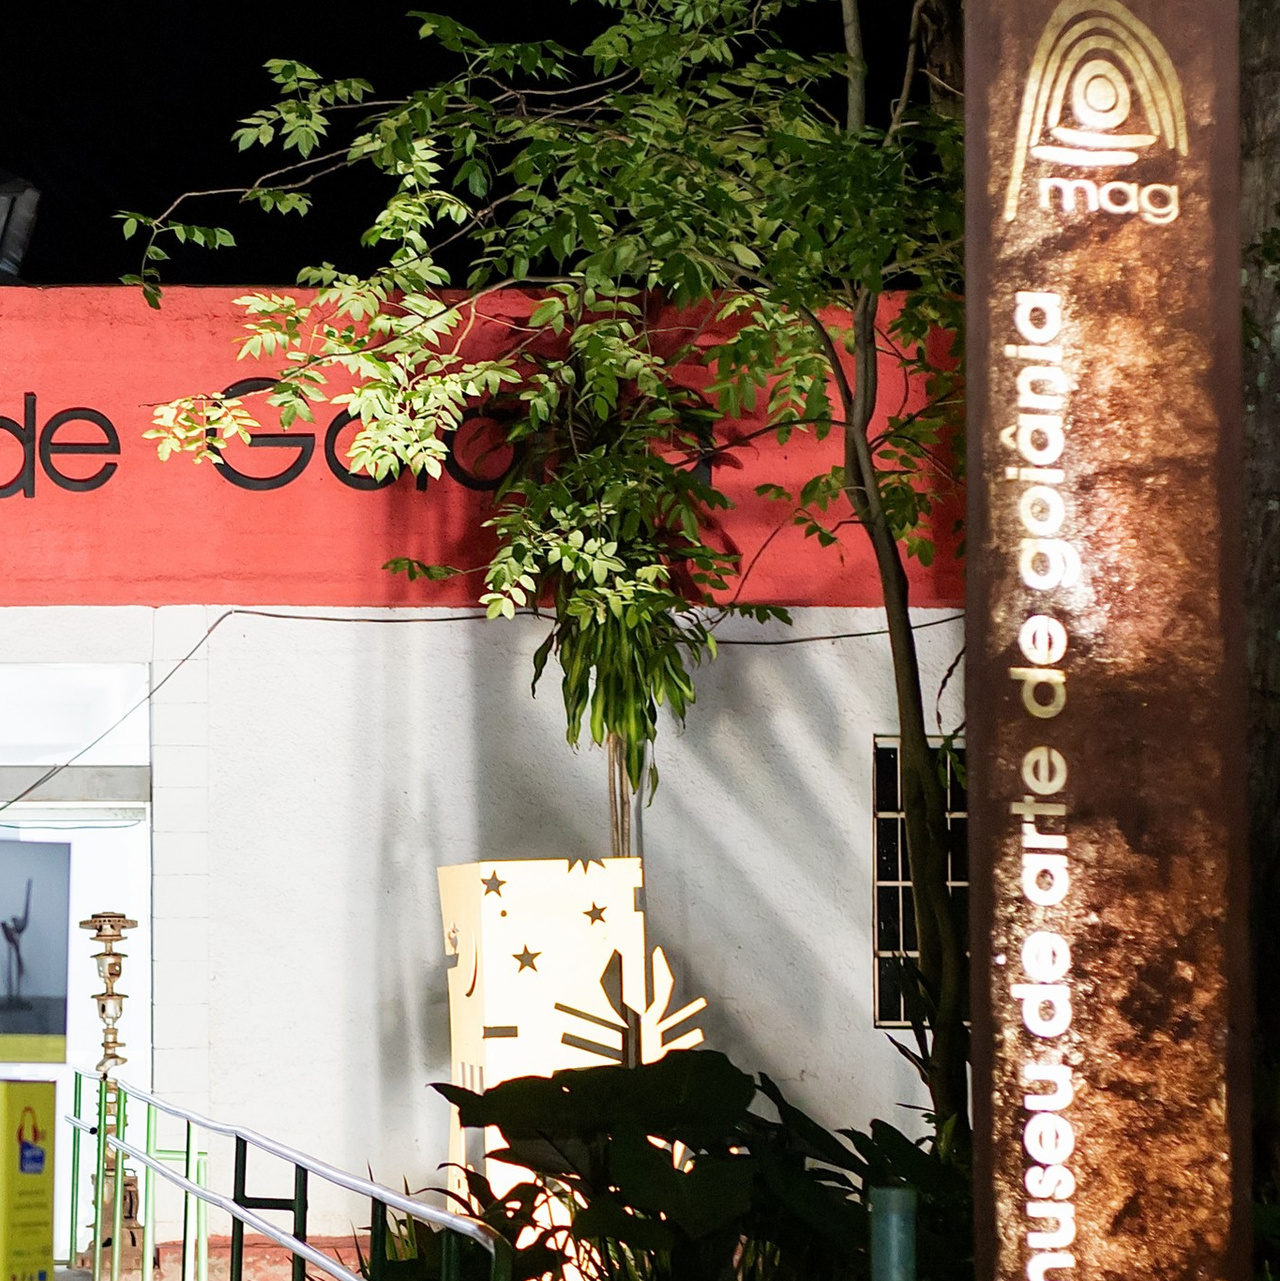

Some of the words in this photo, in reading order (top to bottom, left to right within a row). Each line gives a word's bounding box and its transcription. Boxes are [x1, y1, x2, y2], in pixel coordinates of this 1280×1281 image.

[1039, 176, 1180, 225] mag
[999, 289, 1082, 592] goiânia
[1009, 613, 1069, 719] de
[1010, 745, 1070, 908] arte
[1011, 929, 1074, 1038] de
